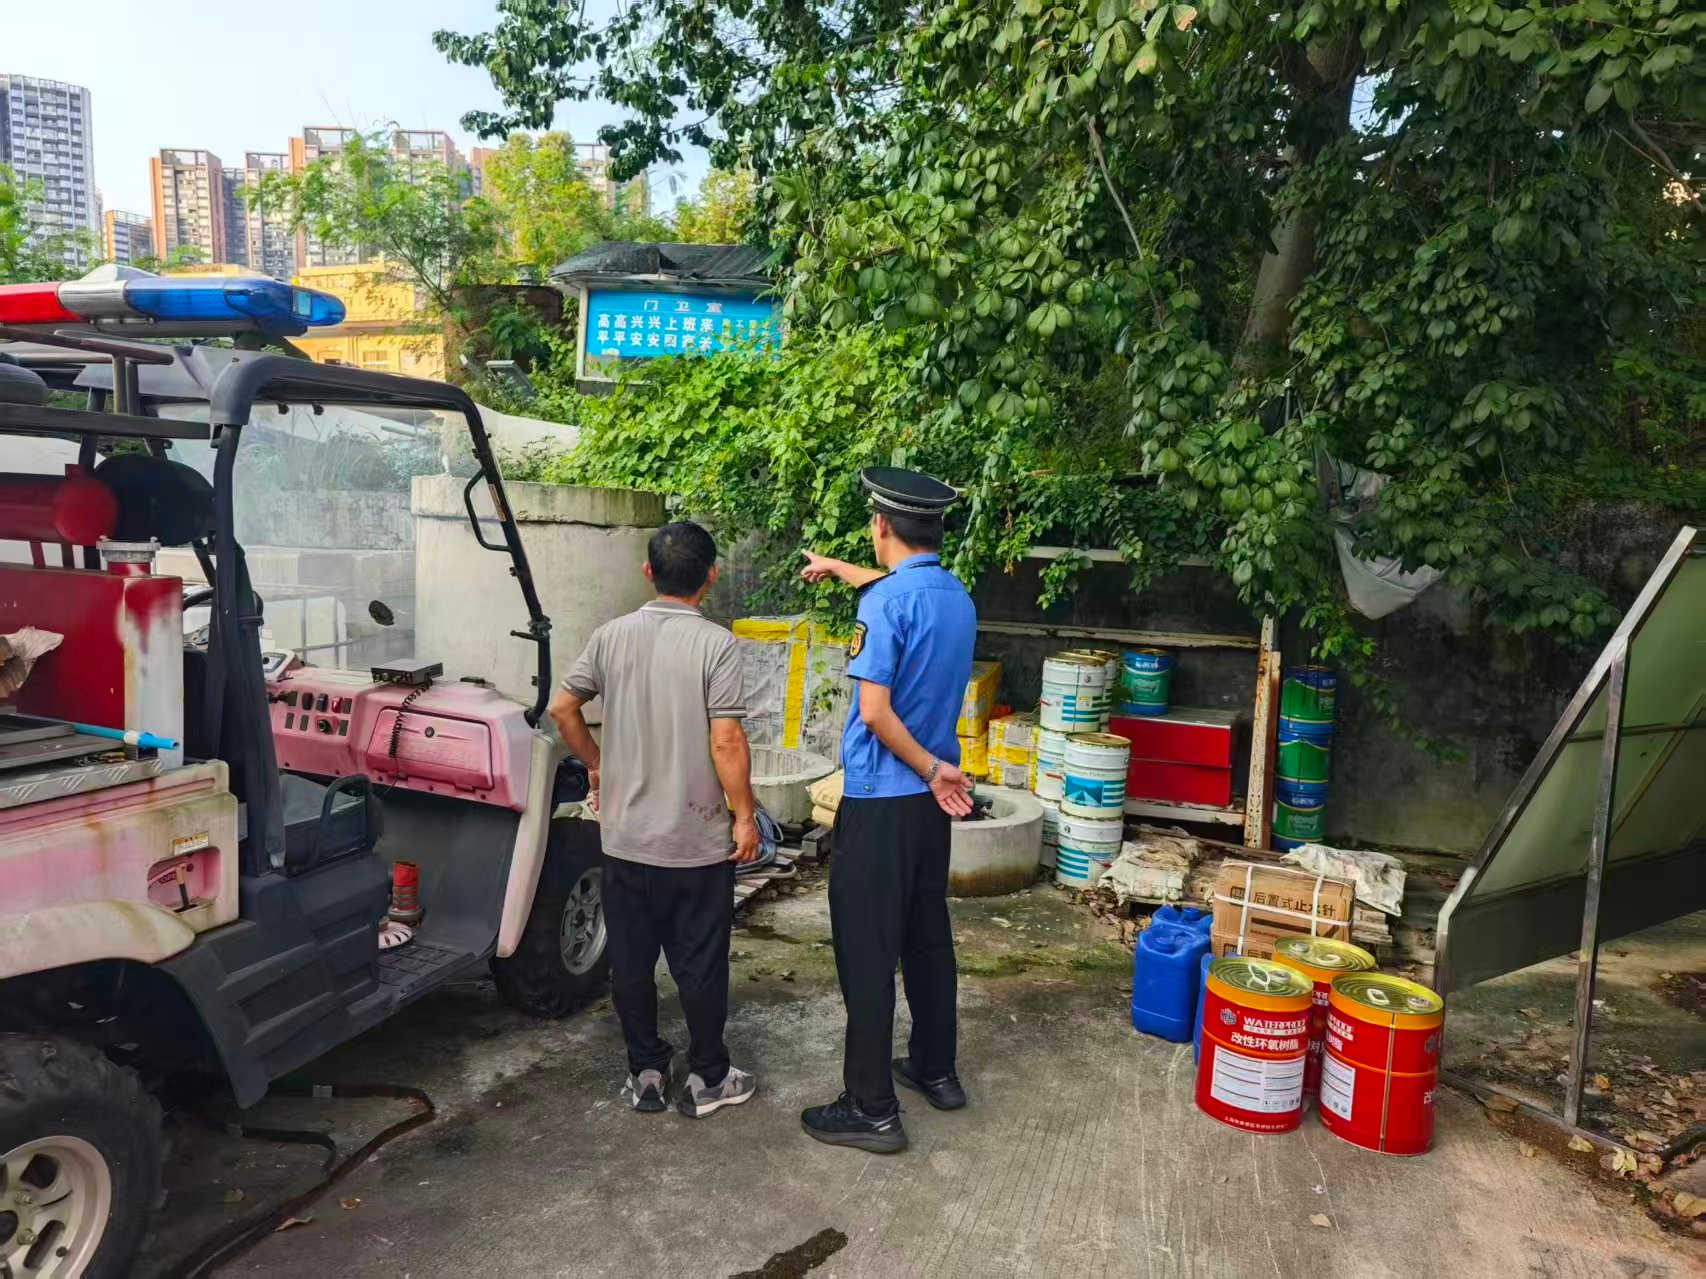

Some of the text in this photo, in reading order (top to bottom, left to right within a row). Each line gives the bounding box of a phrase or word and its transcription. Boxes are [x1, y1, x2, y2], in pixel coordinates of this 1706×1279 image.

[643, 299, 722, 313] 门卫室
[598, 313, 714, 332] 高高兴兴上班来
